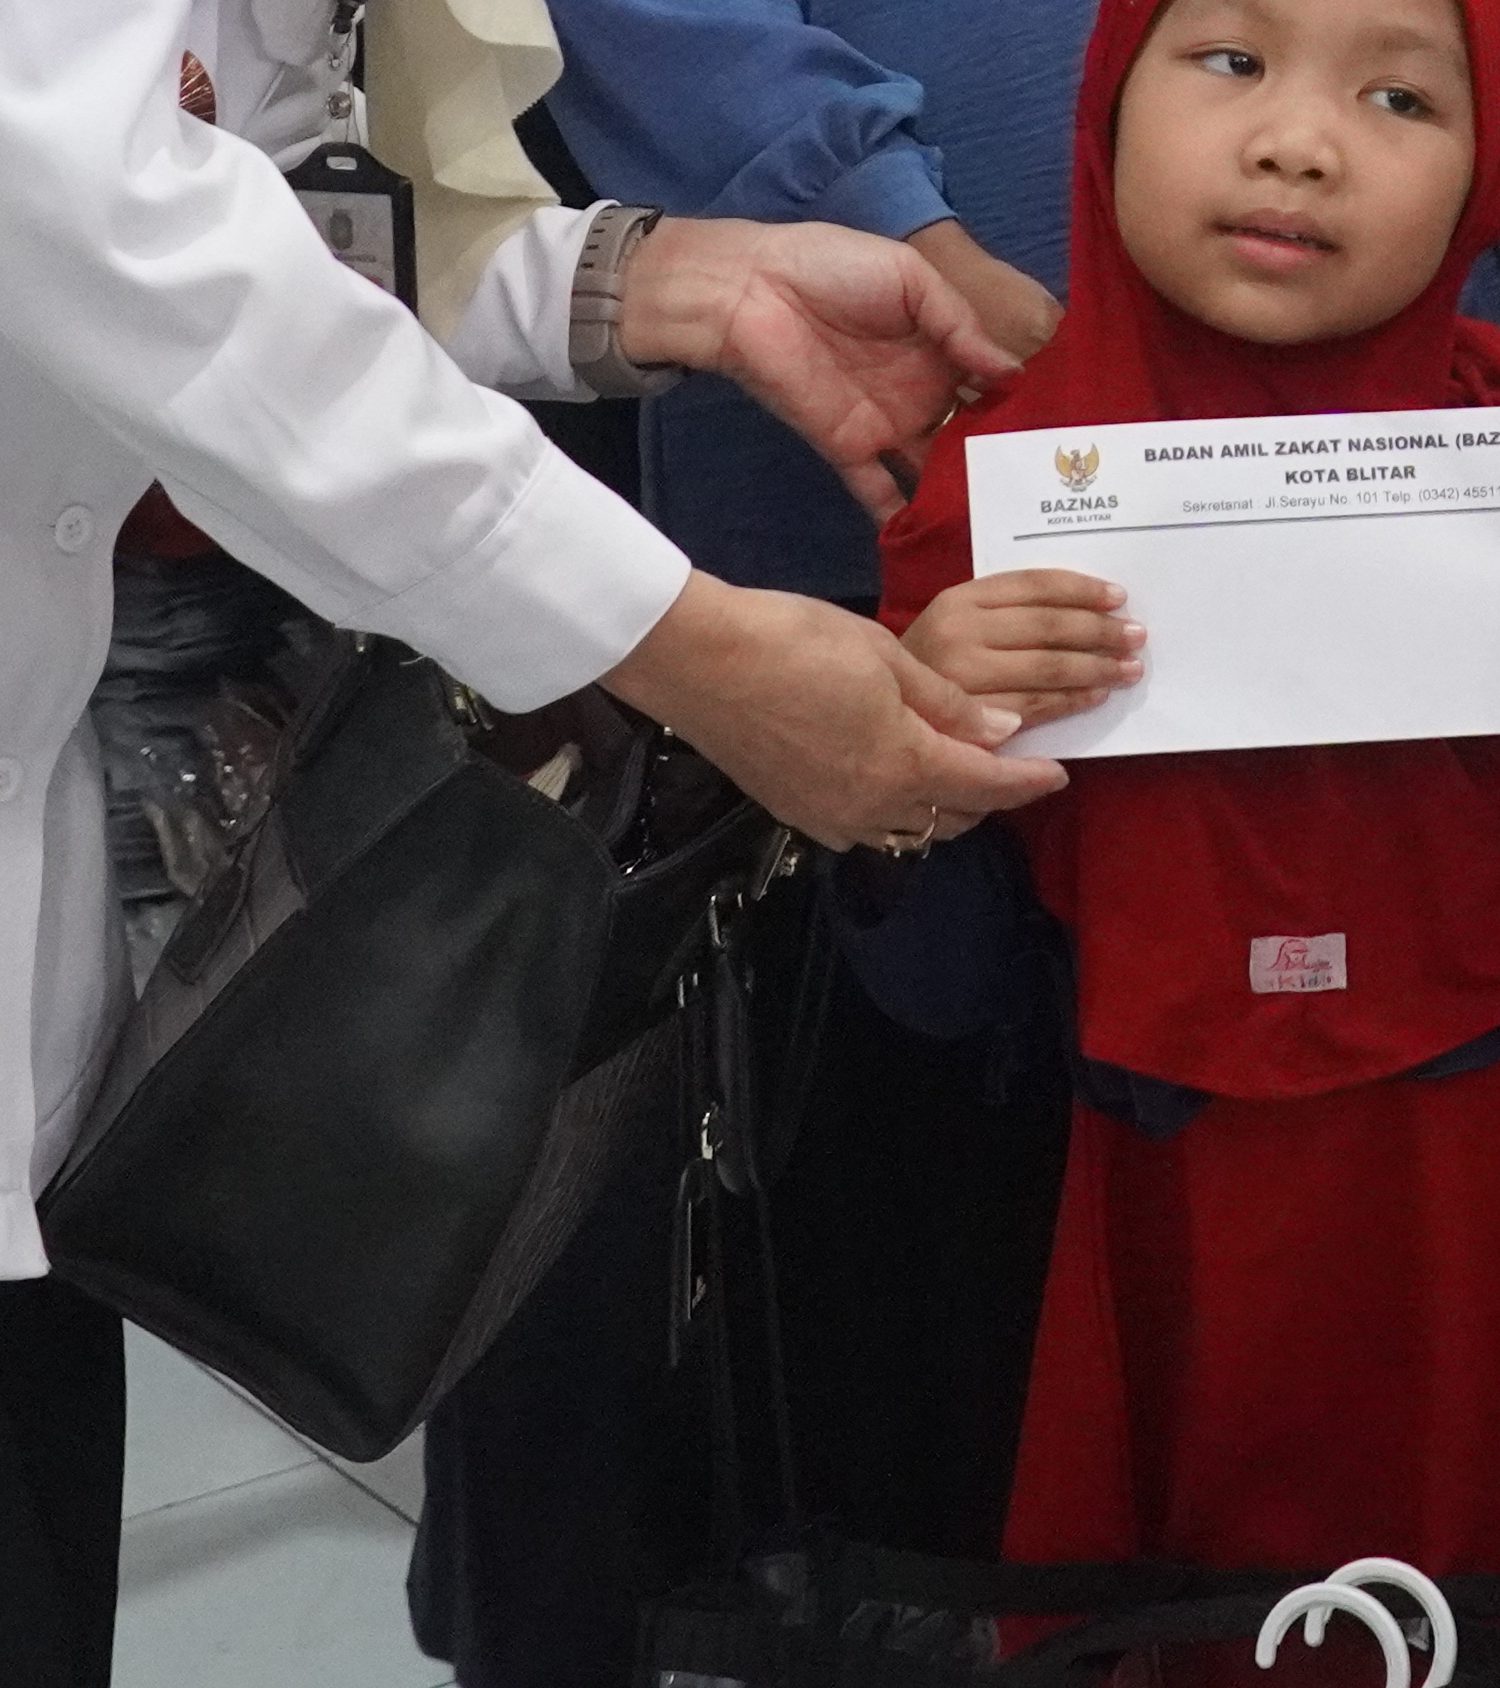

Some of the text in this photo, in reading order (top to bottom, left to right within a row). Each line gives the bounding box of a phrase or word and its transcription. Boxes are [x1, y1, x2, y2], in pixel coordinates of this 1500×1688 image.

[1144, 446, 1214, 462] BADAN
[1220, 443, 1269, 458] AMIL
[1274, 439, 1342, 455] ZAKAT
[1348, 434, 1449, 452] NASIONAL
[1285, 465, 1417, 485] KOTA BLITAR
[1040, 495, 1119, 513] BAZNAS
[1183, 498, 1253, 513] Sekretariat
[1357, 491, 1379, 504] 101
[1418, 487, 1460, 503] (0342)
[1047, 515, 1074, 526] KOTA
